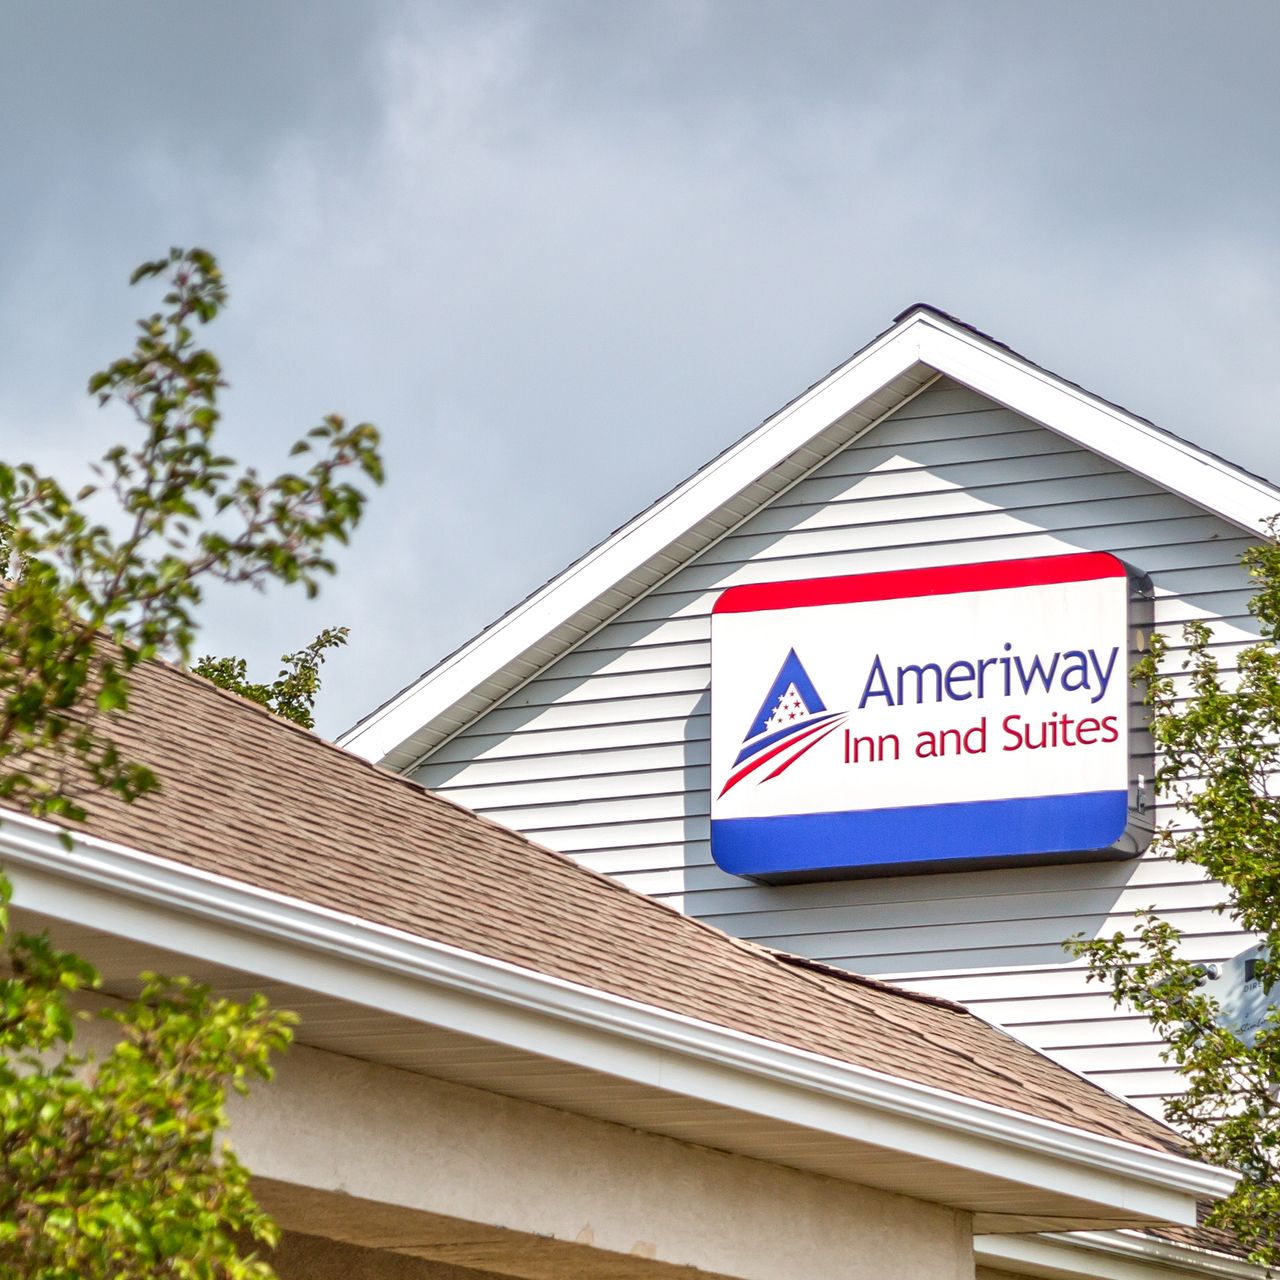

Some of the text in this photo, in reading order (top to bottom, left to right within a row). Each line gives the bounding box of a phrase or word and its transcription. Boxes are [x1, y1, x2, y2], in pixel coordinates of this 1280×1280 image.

[858, 642, 1119, 710] Ameriway
[844, 711, 1119, 764] Inn and Suites
